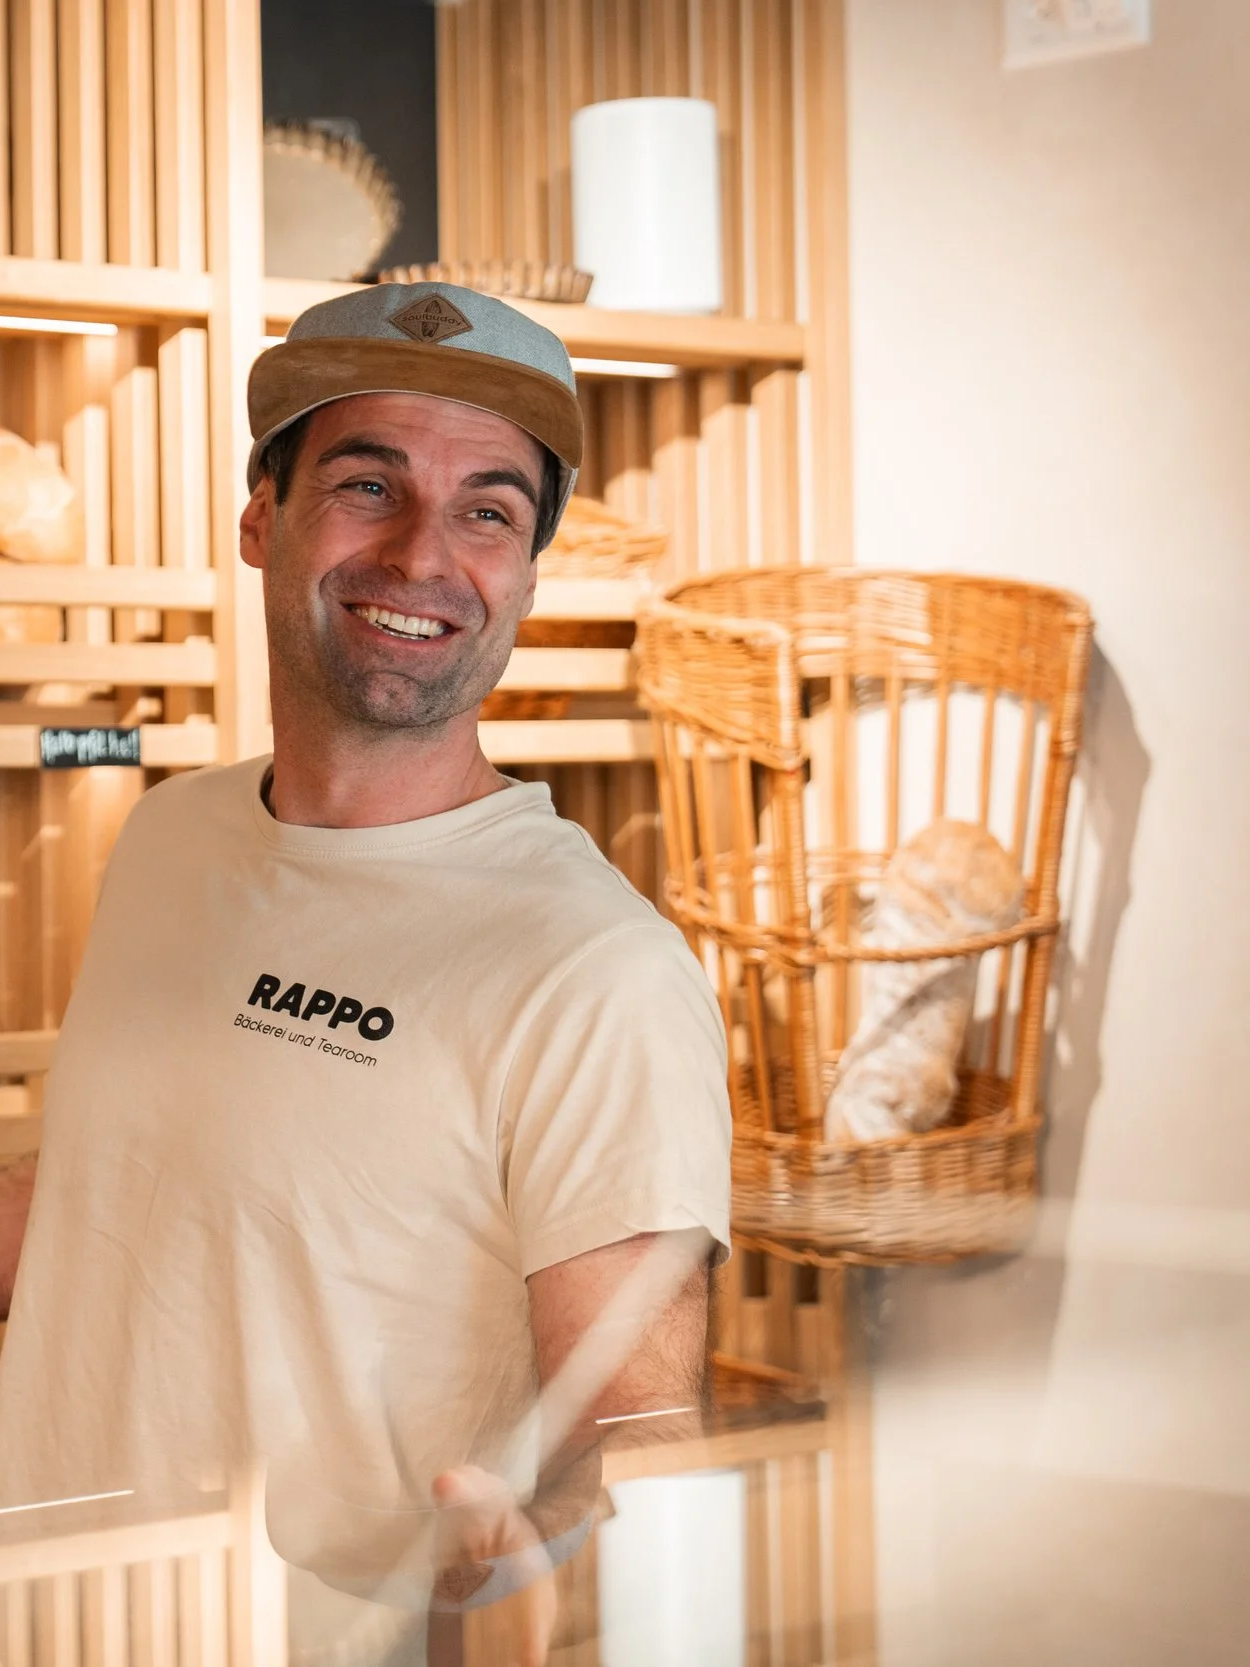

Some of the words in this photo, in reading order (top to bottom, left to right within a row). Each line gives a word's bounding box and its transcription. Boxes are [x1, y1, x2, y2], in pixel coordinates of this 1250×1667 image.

[247, 973, 395, 1041] RAPPO
[233, 1013, 288, 1039] Bäckerei
[288, 1030, 316, 1048] und
[317, 1037, 378, 1067] Tearoom
